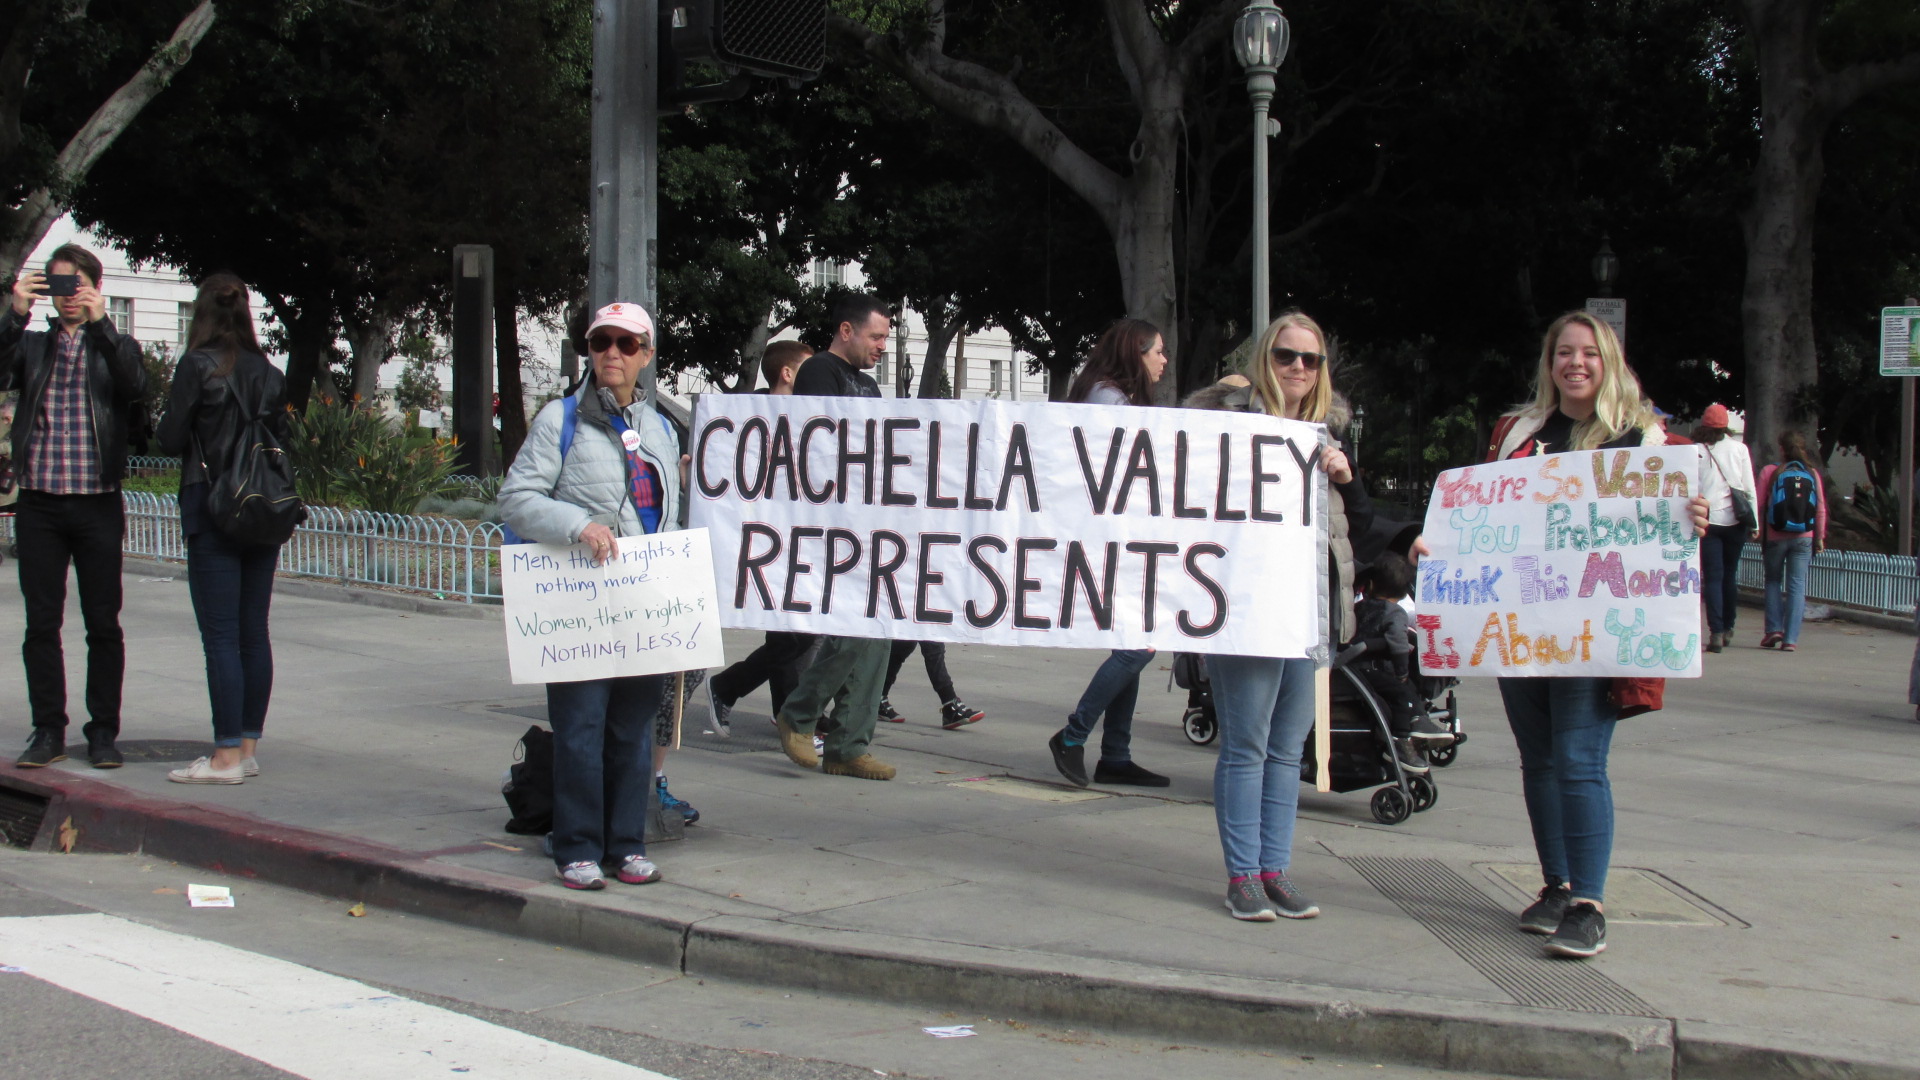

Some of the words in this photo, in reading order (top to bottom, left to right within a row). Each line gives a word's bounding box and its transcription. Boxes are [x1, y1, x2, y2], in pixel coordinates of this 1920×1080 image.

[694, 414, 1042, 512] COACHELLA
[1070, 425, 1321, 526] VALLEY
[1437, 467, 1528, 509] You're
[1532, 456, 1584, 504] So
[1592, 450, 1689, 498] Vain
[513, 552, 559, 572] Men,
[568, 550, 614, 569] ther
[623, 541, 675, 573] rights
[1450, 507, 1519, 554] You
[1545, 499, 1699, 561] Probably
[536, 576, 597, 601] nothing
[734, 521, 1229, 638] REPRESENTS
[1417, 560, 1503, 605] Think
[1512, 555, 1570, 604] This
[1578, 551, 1700, 598] March
[515, 612, 592, 637] Women,
[593, 606, 637, 626] their
[645, 597, 693, 627] rights
[1416, 614, 1461, 669] Is
[1469, 612, 1594, 667] About
[1604, 608, 1697, 670] You
[541, 640, 626, 667] NOTHING
